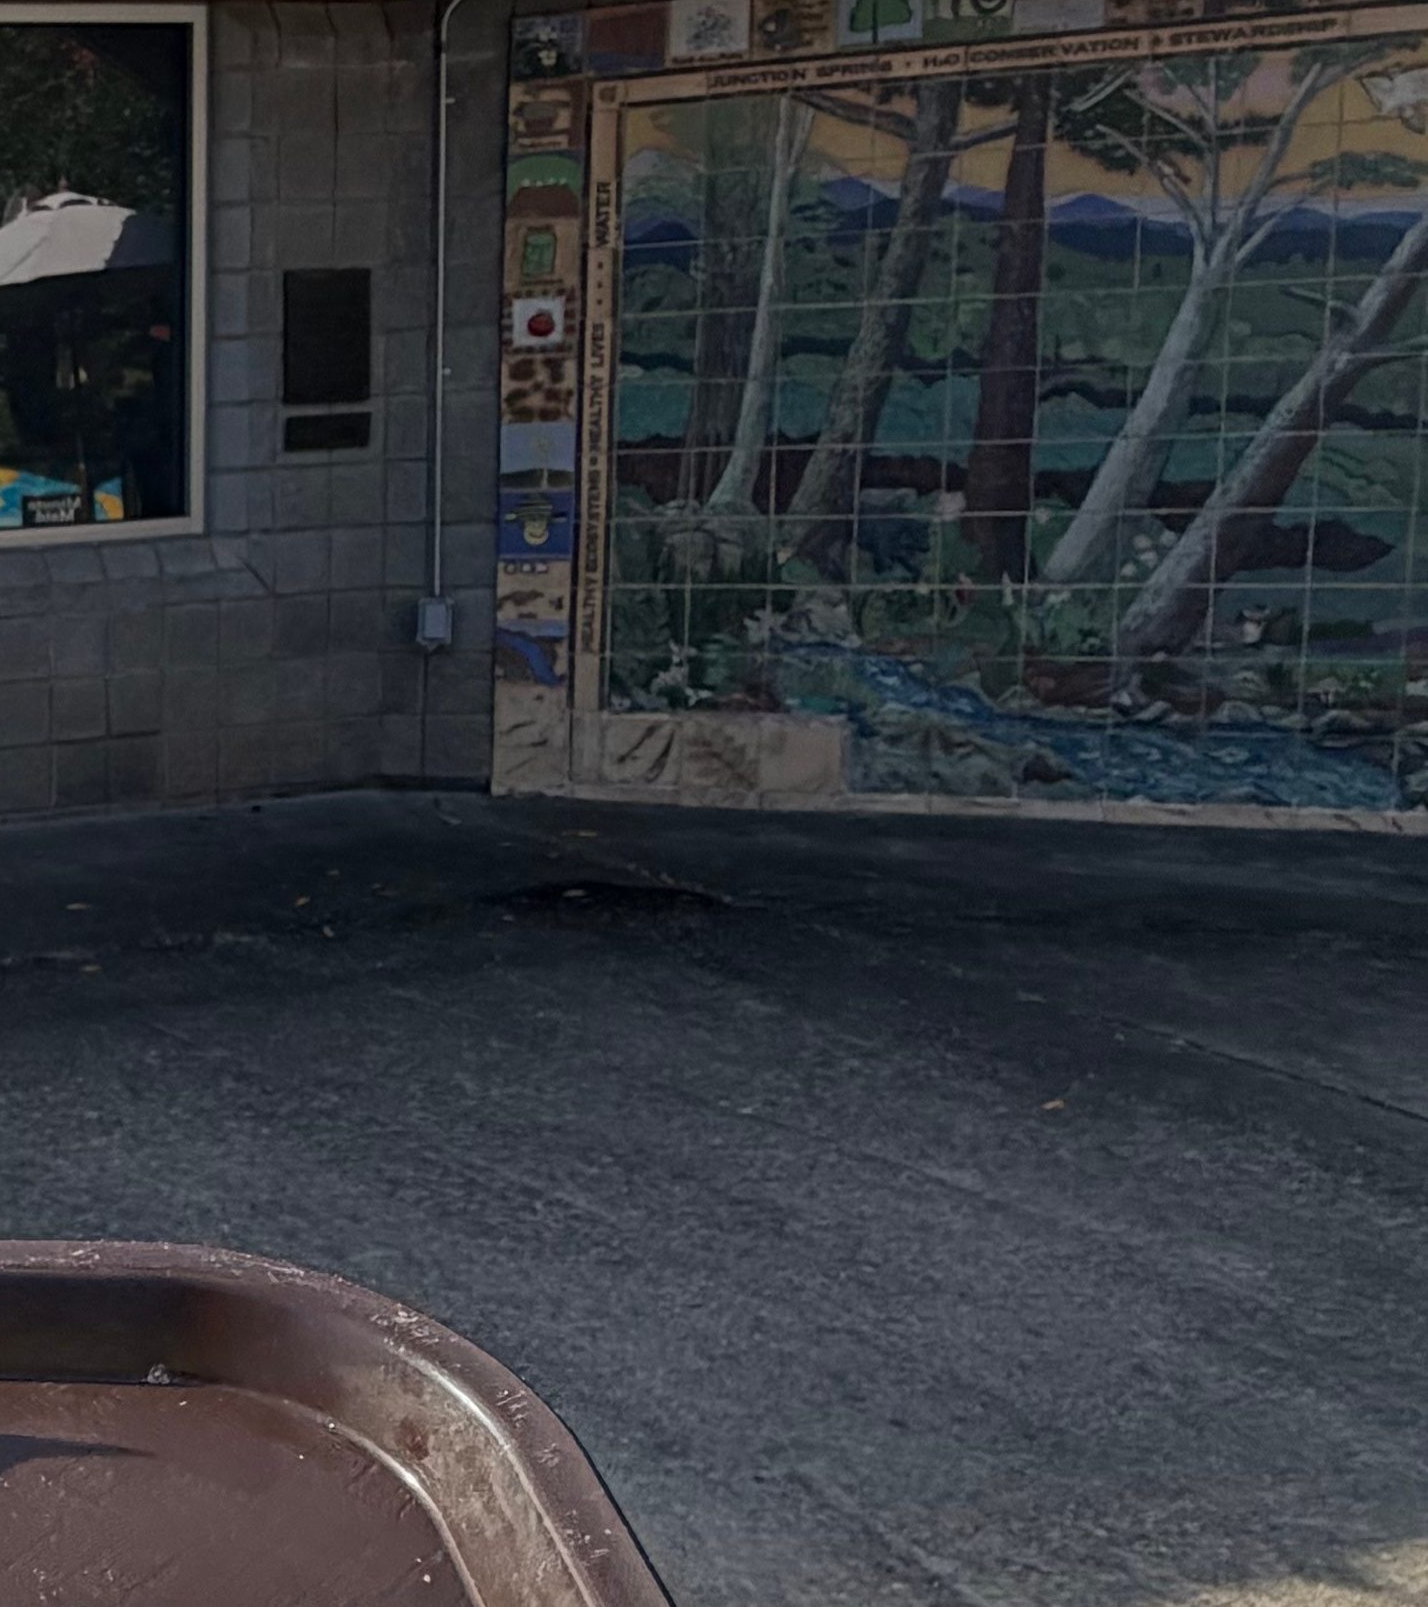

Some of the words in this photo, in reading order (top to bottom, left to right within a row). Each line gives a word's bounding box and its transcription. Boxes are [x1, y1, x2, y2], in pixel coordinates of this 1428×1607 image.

[711, 68, 807, 88] JUNCTION
[815, 61, 893, 78] SPRINGS
[969, 37, 1141, 64] CONSERVATION
[1168, 18, 1337, 47] STEWARDSHIP
[595, 181, 611, 247] WATER
[590, 322, 605, 369] LIVES
[588, 375, 604, 451] HEALTHY
[581, 577, 598, 653] HEALTHY
